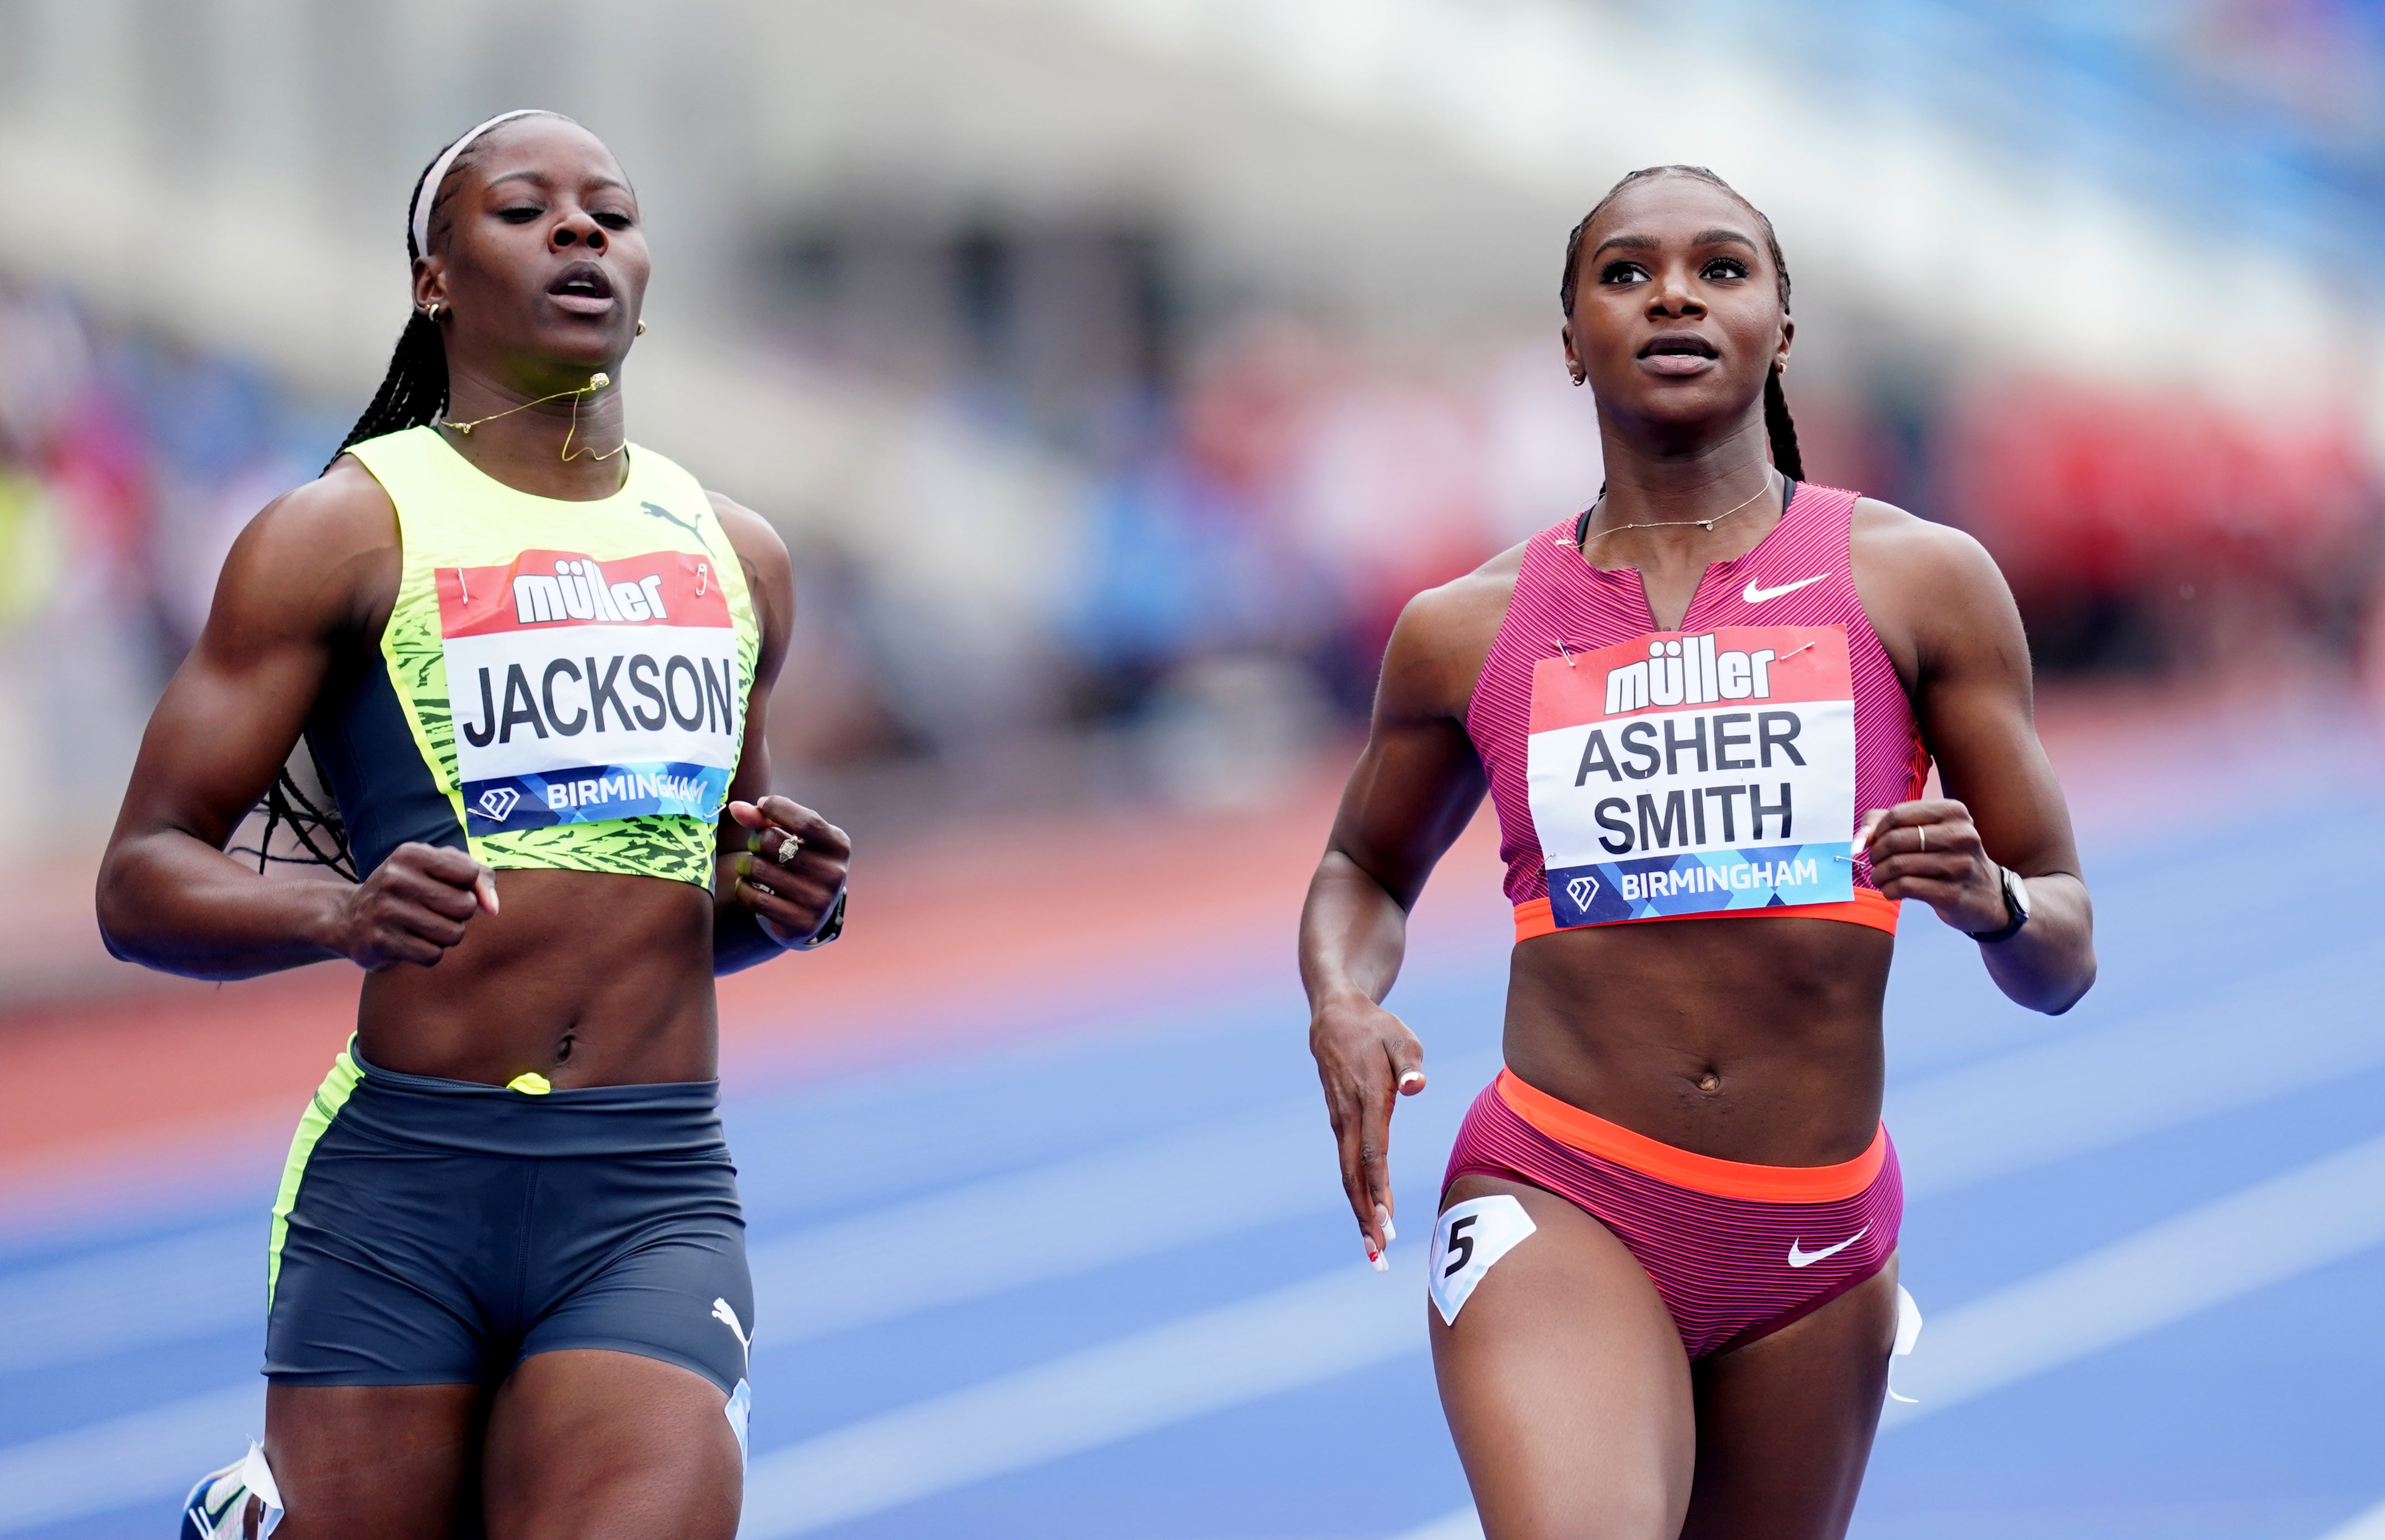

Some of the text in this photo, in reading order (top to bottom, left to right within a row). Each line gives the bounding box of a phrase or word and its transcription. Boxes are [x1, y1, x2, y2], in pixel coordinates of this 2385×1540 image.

[513, 557, 668, 624] müller
[463, 654, 732, 748] JACKSON
[1604, 633, 1776, 715] müller
[1575, 710, 1807, 787] ASHER
[547, 773, 708, 810] BIRMINGHAM
[1594, 783, 1792, 855] SMITH
[1621, 858, 1818, 901] BIRMINGHAM
[1444, 1214, 1479, 1279] 5
